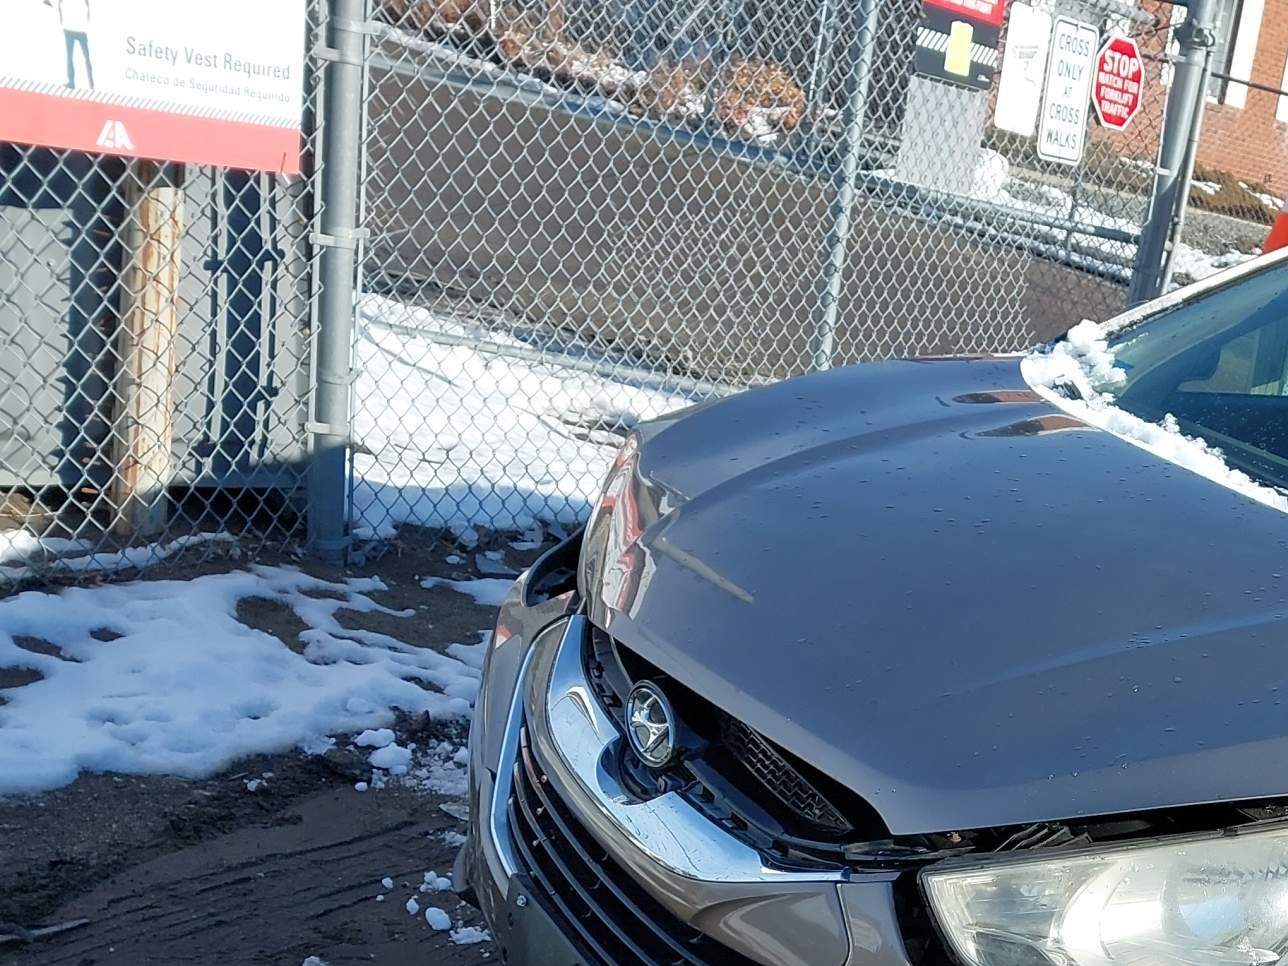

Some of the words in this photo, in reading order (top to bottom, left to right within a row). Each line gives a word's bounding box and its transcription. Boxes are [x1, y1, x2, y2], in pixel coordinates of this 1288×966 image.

[1059, 33, 1090, 57] CROSS
[126, 35, 178, 67] Safety
[184, 45, 217, 68] Vest
[223, 53, 290, 80] Required
[1103, 49, 1139, 79] STOP
[1057, 59, 1085, 81] ONLY
[125, 67, 170, 85] Chaleco
[173, 77, 186, 88] de
[188, 77, 241, 97] Seguridad
[1124, 79, 1139, 94] FOR
[1050, 102, 1080, 125] CROSS
[1101, 100, 1130, 119] TRAFFIC
[1046, 129, 1077, 150] WALKS
